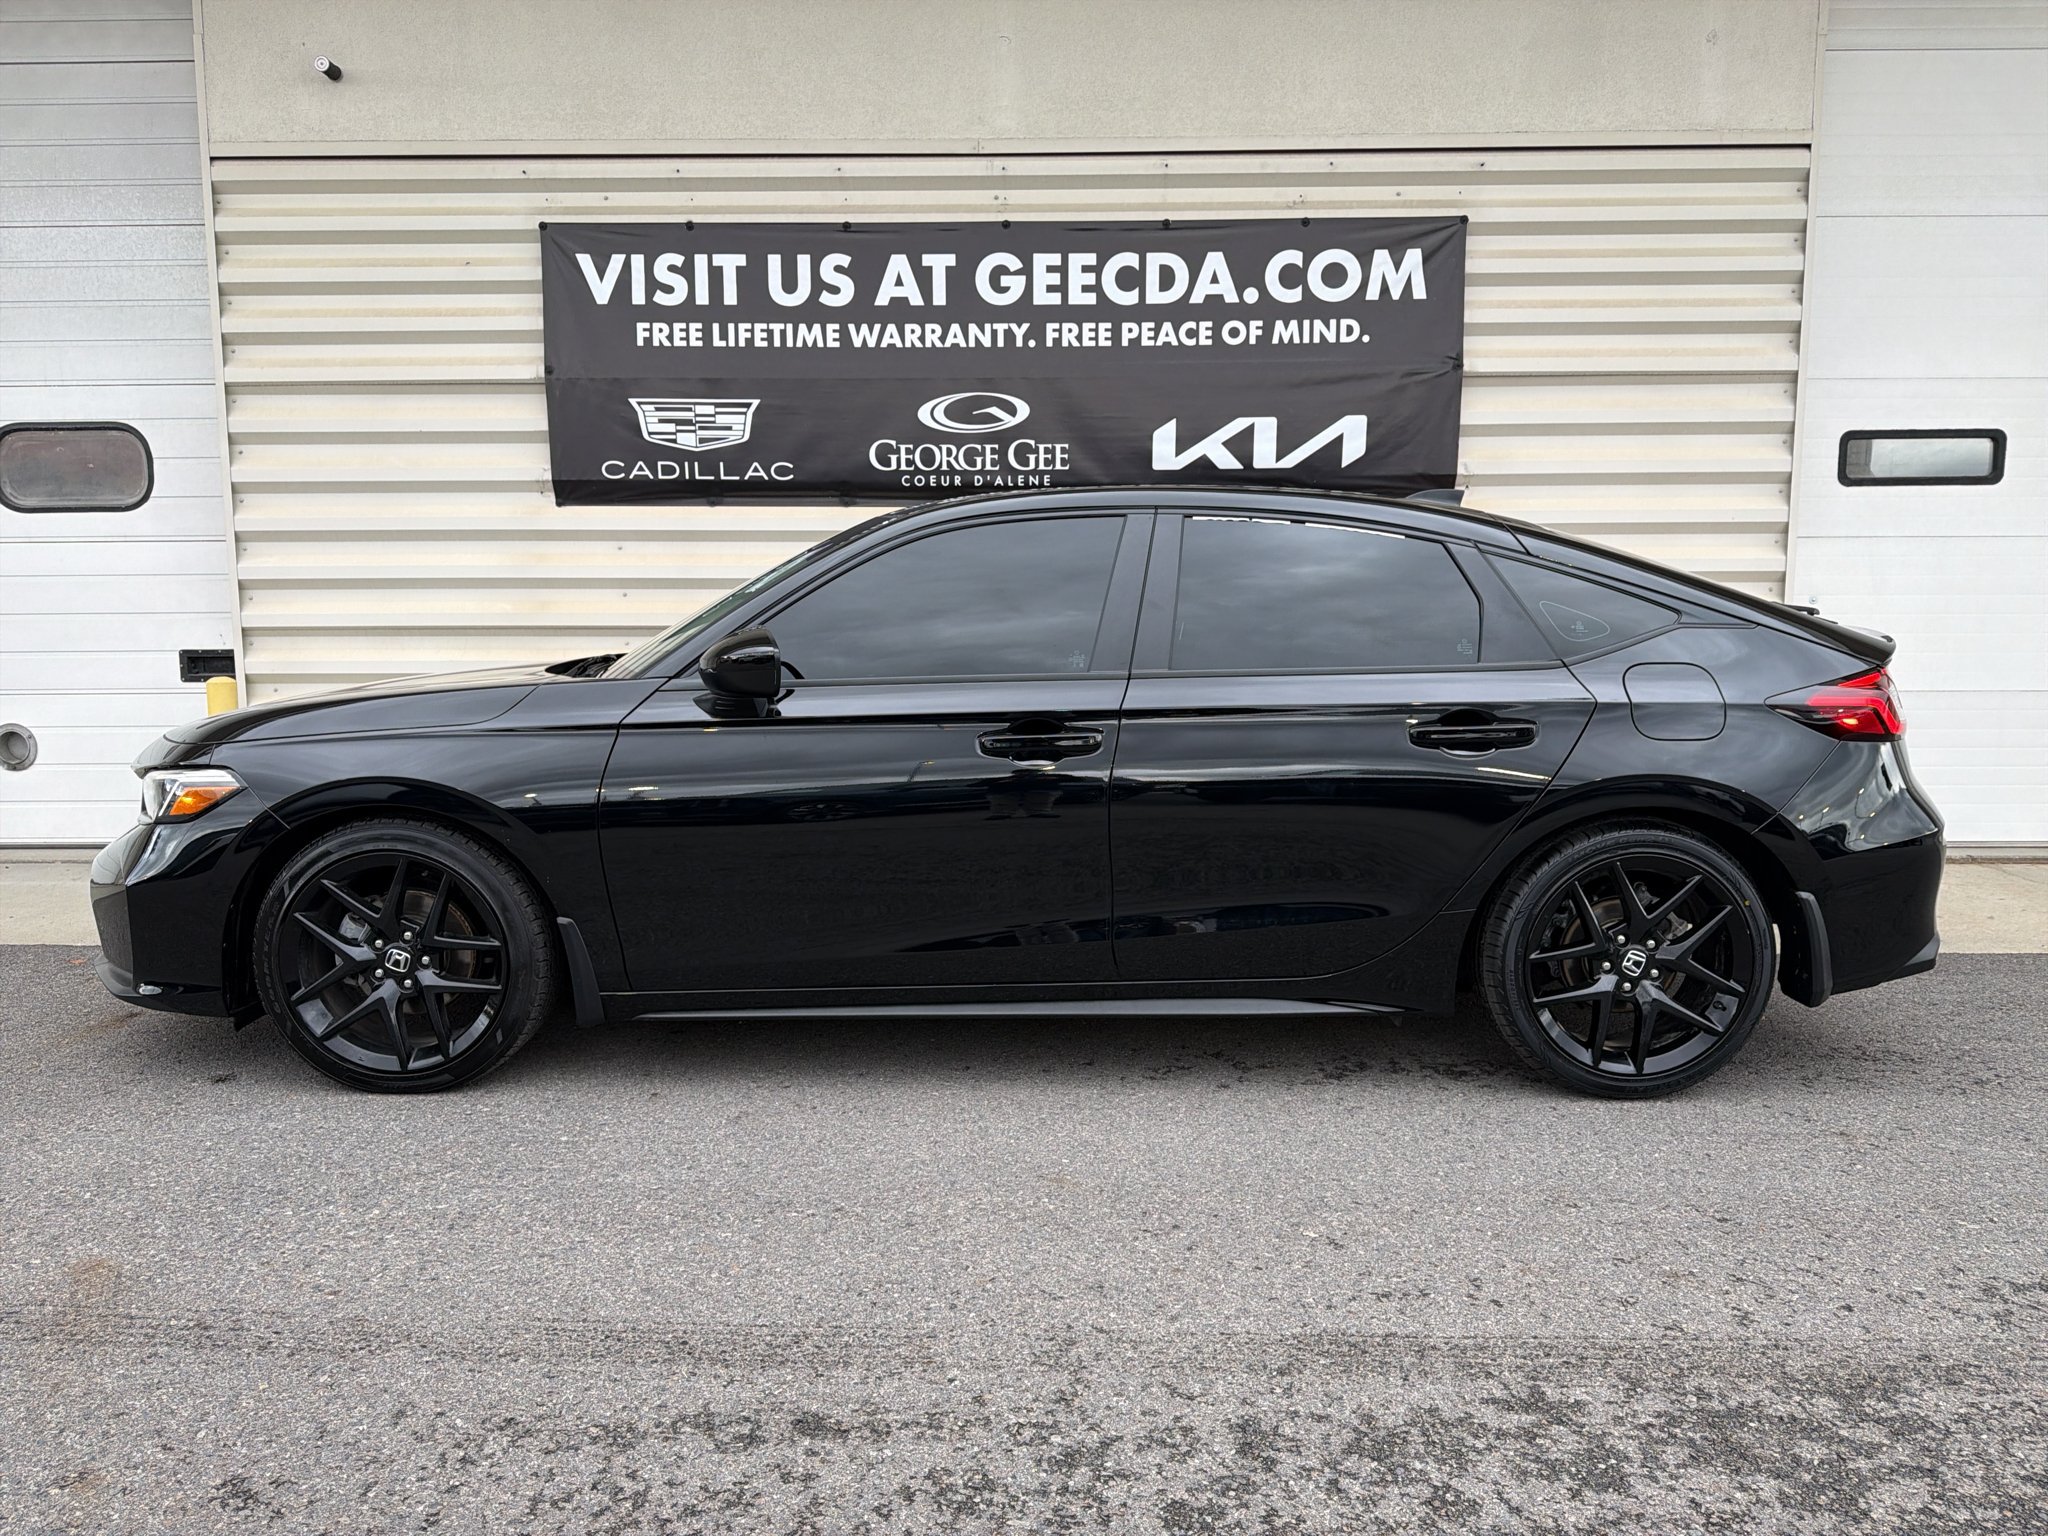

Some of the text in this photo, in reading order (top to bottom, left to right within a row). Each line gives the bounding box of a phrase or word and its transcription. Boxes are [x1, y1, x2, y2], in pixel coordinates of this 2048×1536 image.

[574, 247, 1427, 308] VISIT US AT GEECDA.COM
[636, 318, 1371, 348] FREE LIFETIME WARRANTY. FREE PEACE OF MIND.
[868, 438, 1070, 472] GEORGE GEE
[601, 460, 794, 481] CADILLAC
[901, 474, 1051, 487] COEUR D'ALENE
